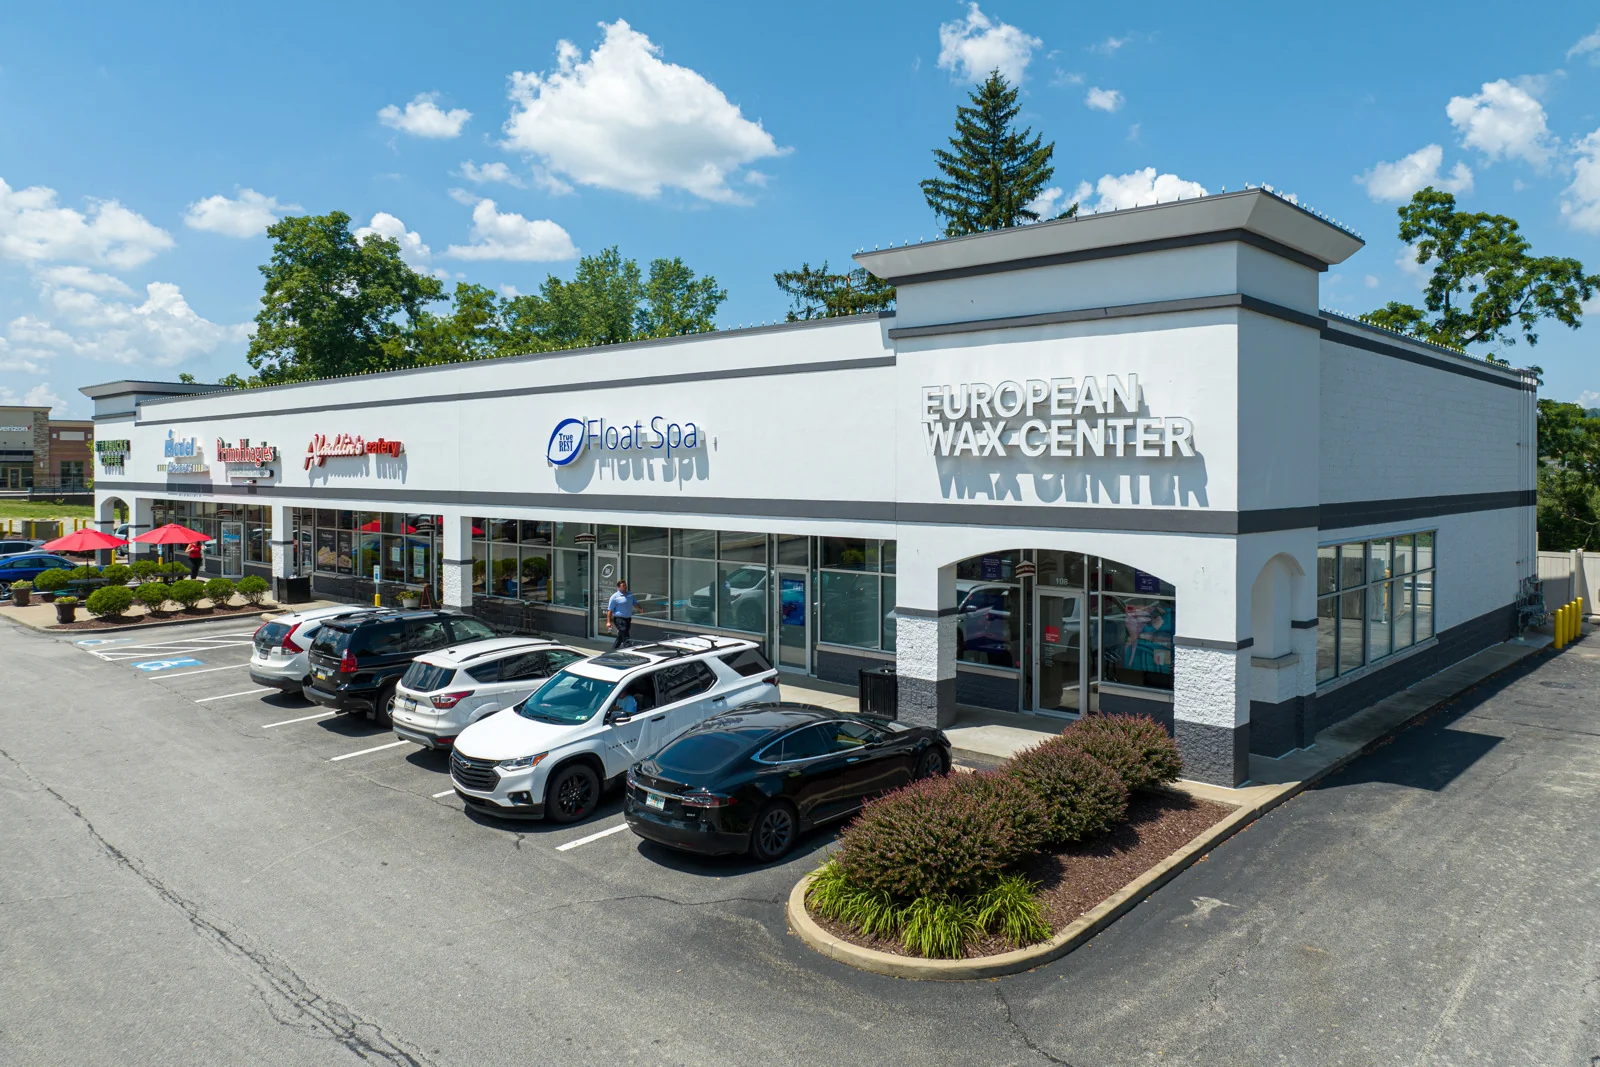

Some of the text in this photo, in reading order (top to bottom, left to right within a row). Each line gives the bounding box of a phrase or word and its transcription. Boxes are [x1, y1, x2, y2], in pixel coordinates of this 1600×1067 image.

[921, 373, 1139, 420] EUROPEAN
[95, 440, 129, 452] STARBUCKS
[558, 433, 574, 441] True
[558, 441, 573, 451] REST
[587, 416, 697, 459] Float Spa
[922, 416, 1196, 457] WAX CENTER
[101, 455, 123, 467] COFFEE
[304, 433, 400, 470] Aladdin's eatery
